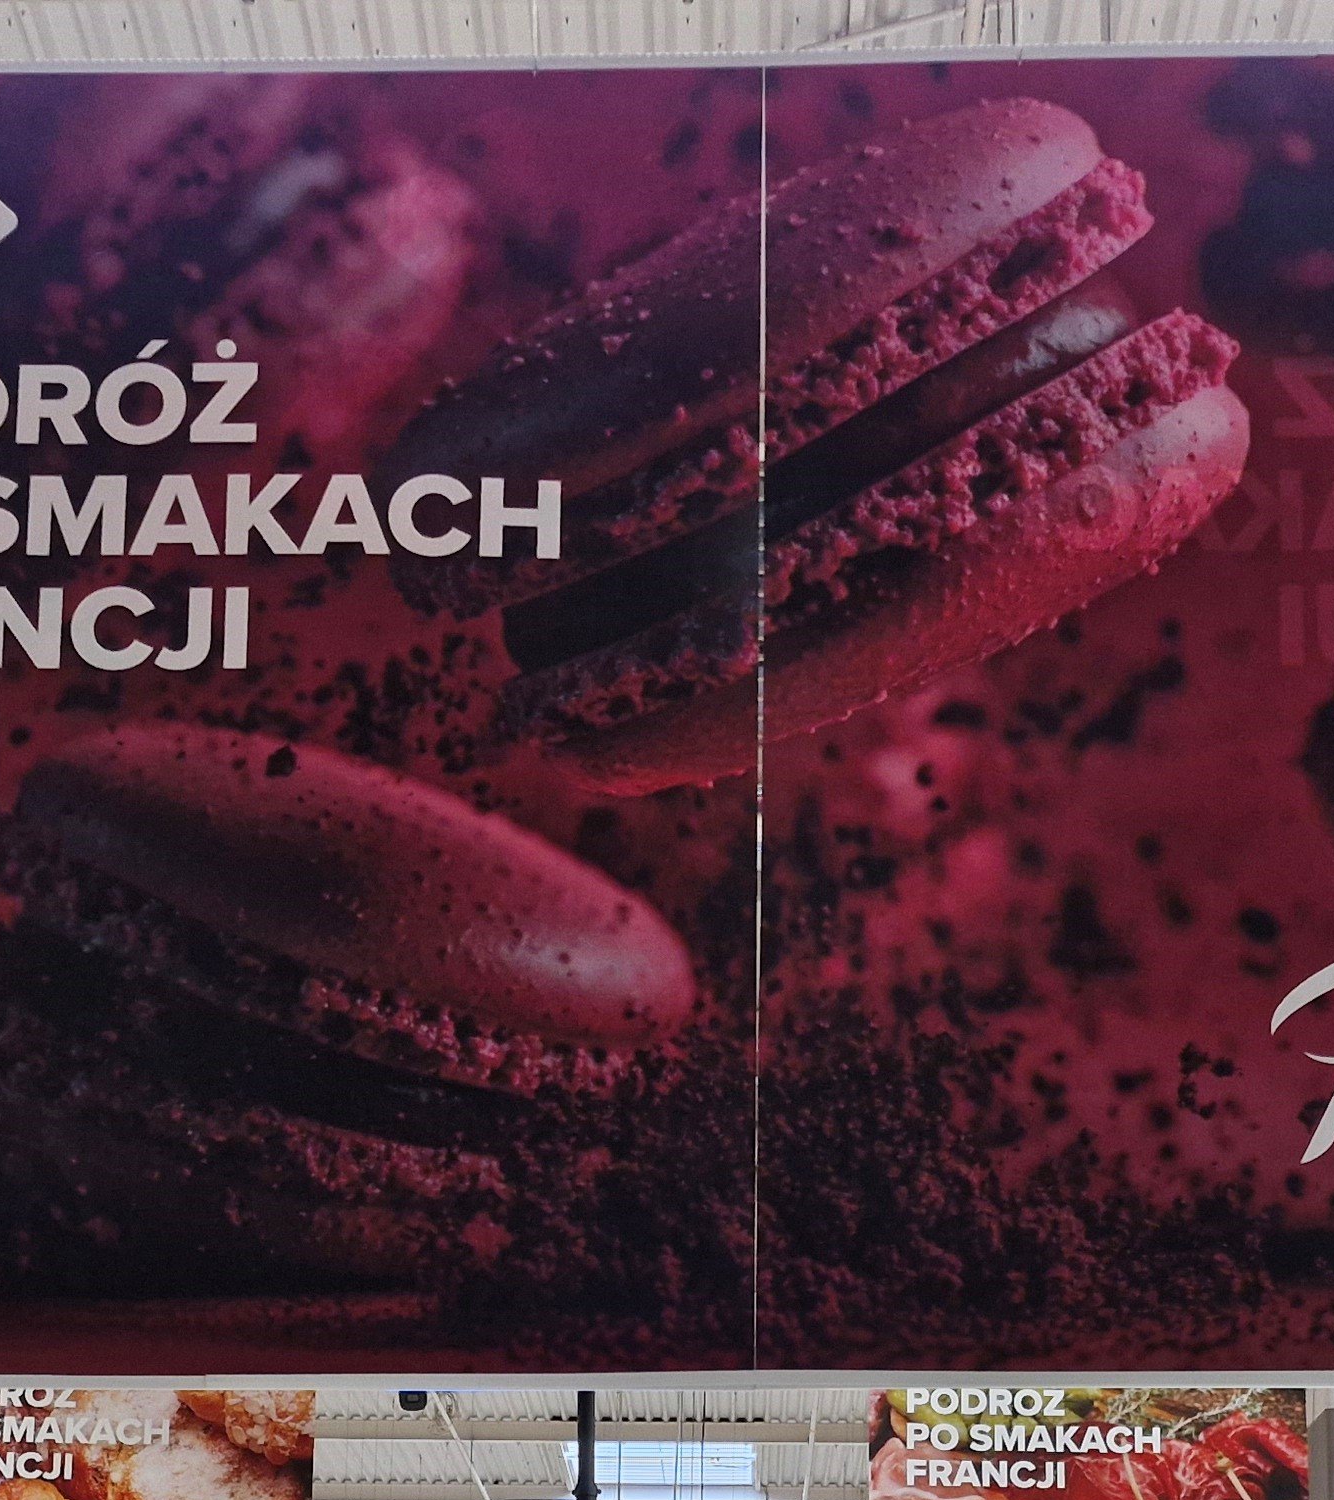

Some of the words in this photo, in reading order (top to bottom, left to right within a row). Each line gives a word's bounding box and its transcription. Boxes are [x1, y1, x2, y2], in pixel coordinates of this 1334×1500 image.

[906, 1423, 964, 1450] PO
[970, 1425, 1161, 1454] SMAKACH
[906, 1460, 1065, 1489] FRANCJI
